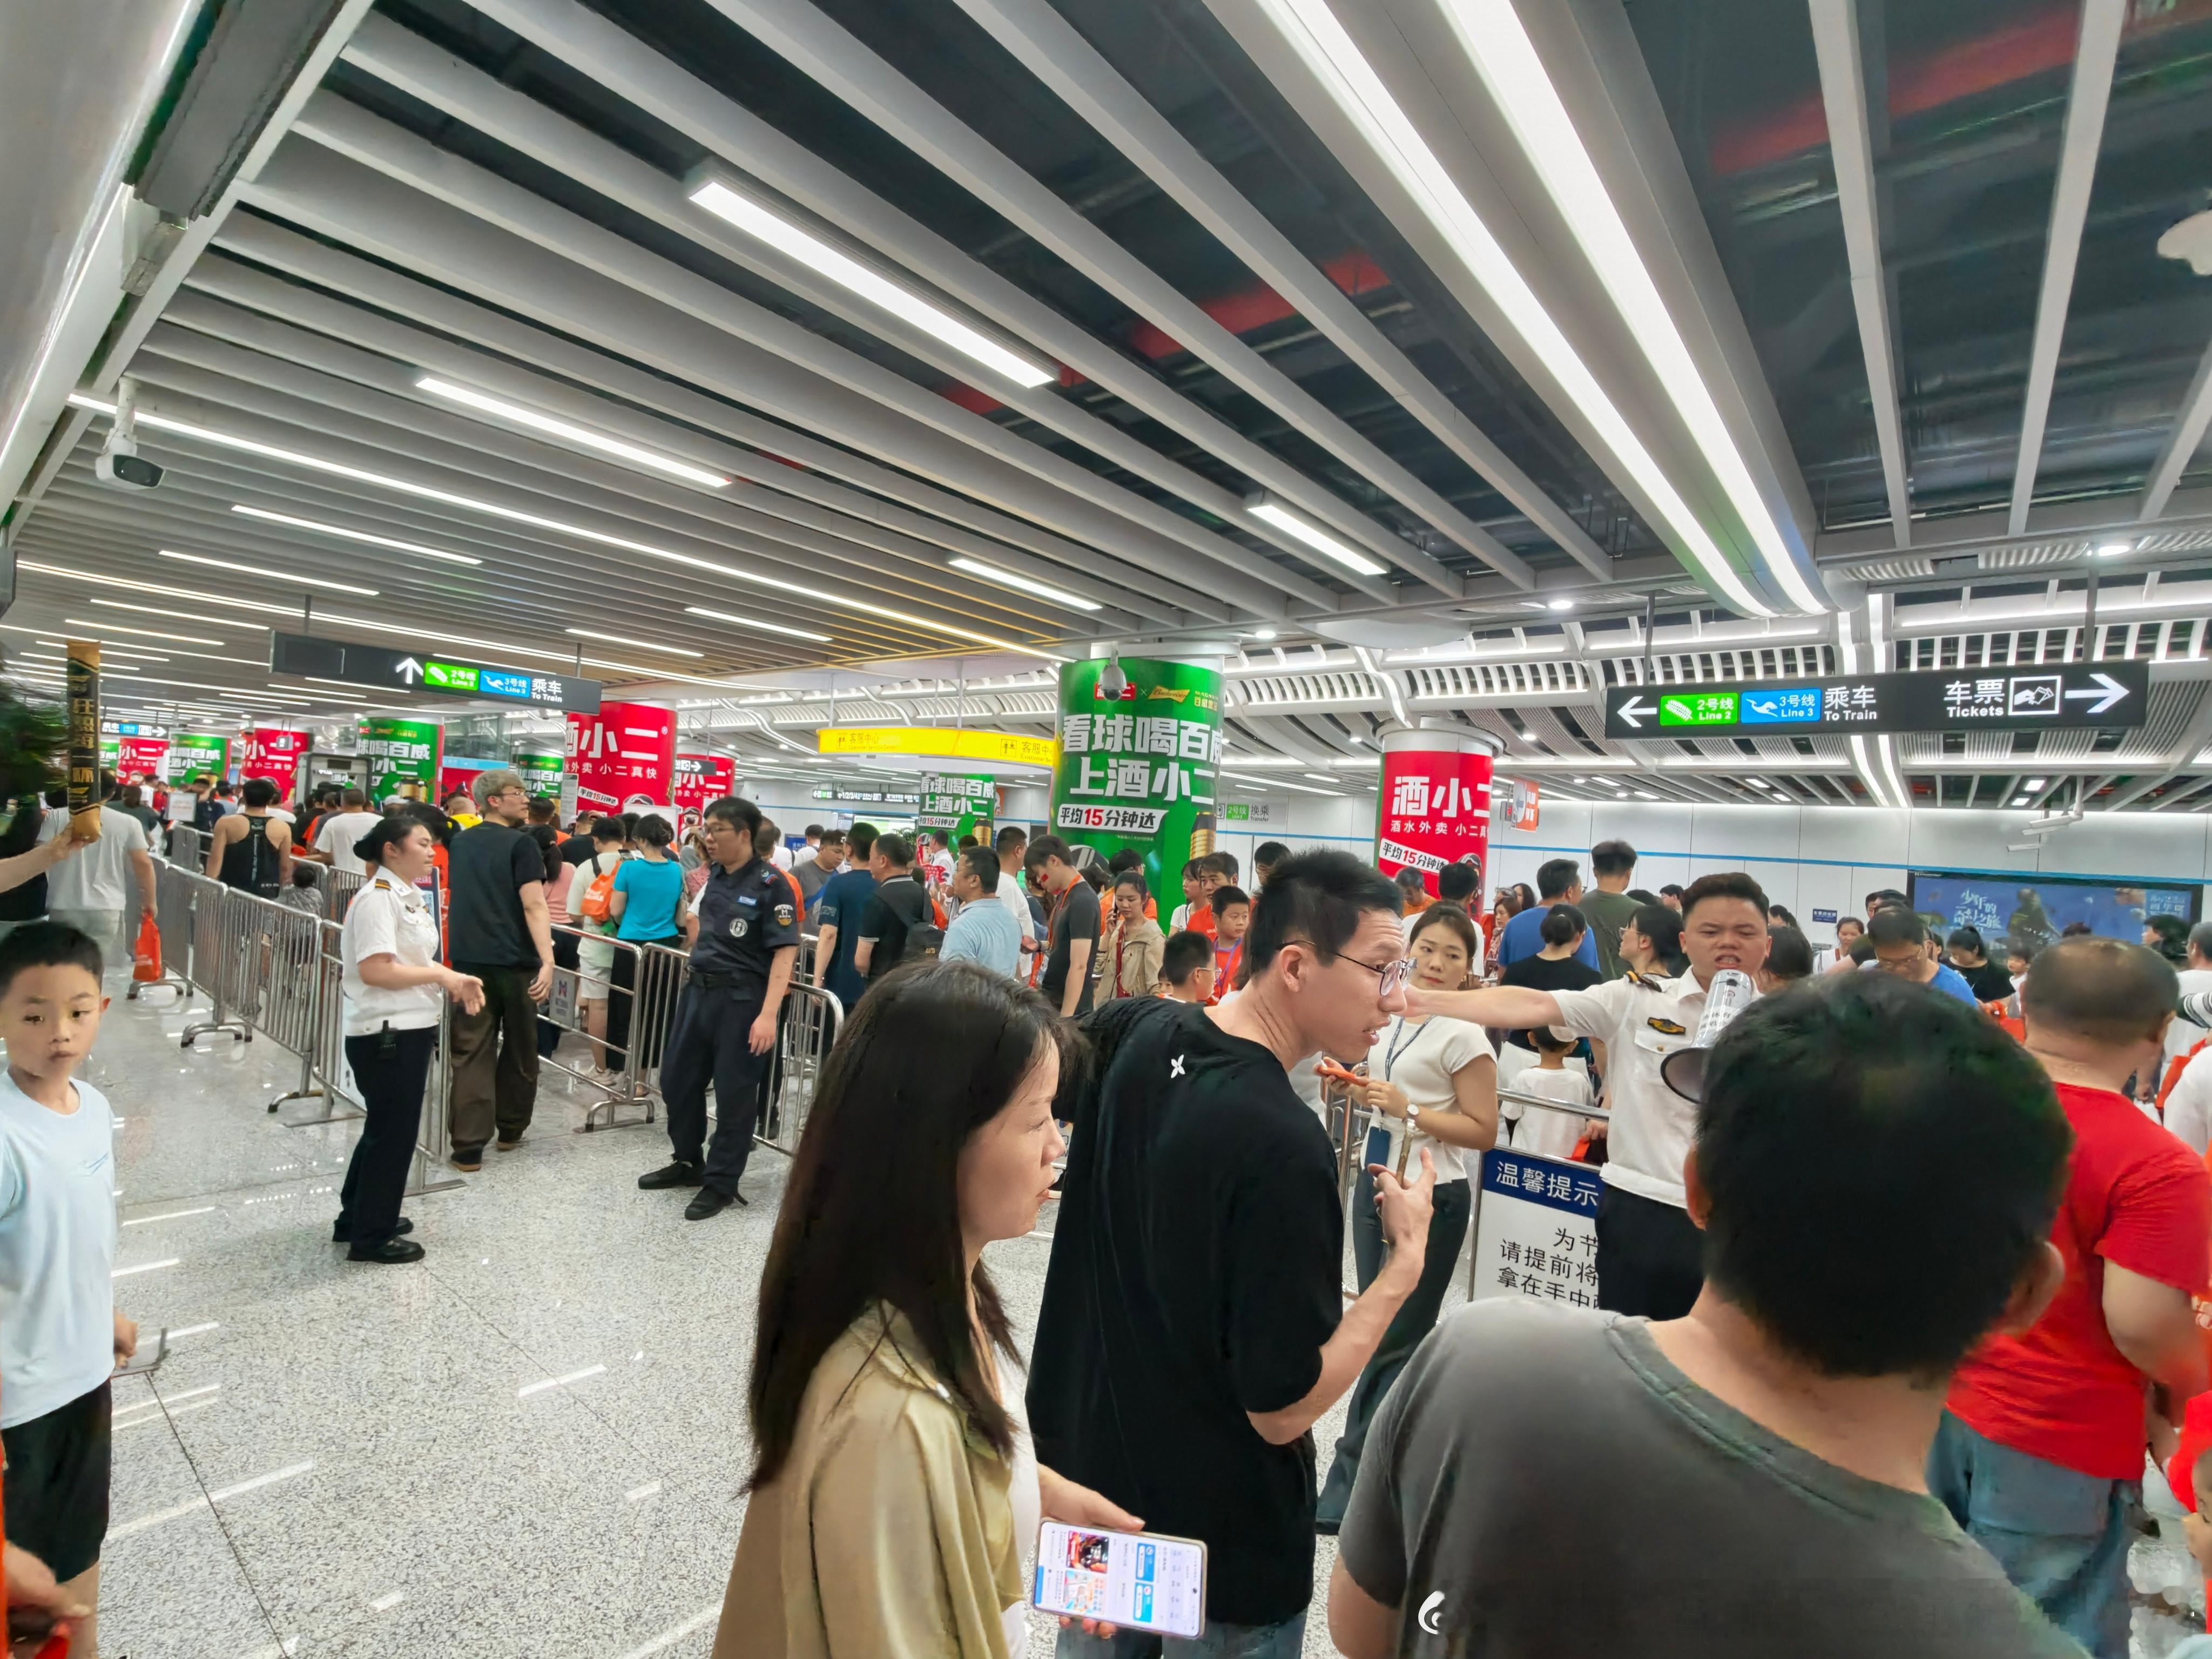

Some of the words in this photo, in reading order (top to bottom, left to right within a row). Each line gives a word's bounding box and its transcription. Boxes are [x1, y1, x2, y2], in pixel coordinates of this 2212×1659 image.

[451, 670, 476, 681] 2号线
[504, 678, 527, 689] 3号线
[531, 677, 562, 695] 乘车
[1944, 679, 2005, 705] 车票
[505, 685, 520, 693] Line
[542, 694, 562, 703] Train
[1697, 697, 1734, 711] 2号线
[1779, 694, 1816, 707] 3号线
[1824, 685, 1877, 710] 乘车
[1699, 711, 1722, 721] Line
[1725, 711, 1731, 719] 2
[1781, 708, 1805, 718] Line
[1807, 708, 1813, 717] 3
[1824, 711, 1839, 721] To
[1845, 709, 1878, 720] Train
[1947, 706, 2004, 718] Tickets
[850, 733, 879, 744] 客服中心
[1020, 753, 1045, 762] Customer
[599, 763, 658, 779] 小二真快
[1070, 757, 1216, 805] 上酒小二
[921, 777, 995, 799] 看球喝百威
[1392, 776, 1492, 818] 酒小二
[922, 795, 988, 816] 上酒小二
[1250, 804, 1269, 816] 换乘
[1060, 807, 1156, 829] 平均15分钟达
[1391, 820, 1448, 835] 酒水外卖
[1496, 1161, 1599, 1206] 温馨提示
[1500, 1239, 1599, 1287] 请提前将
